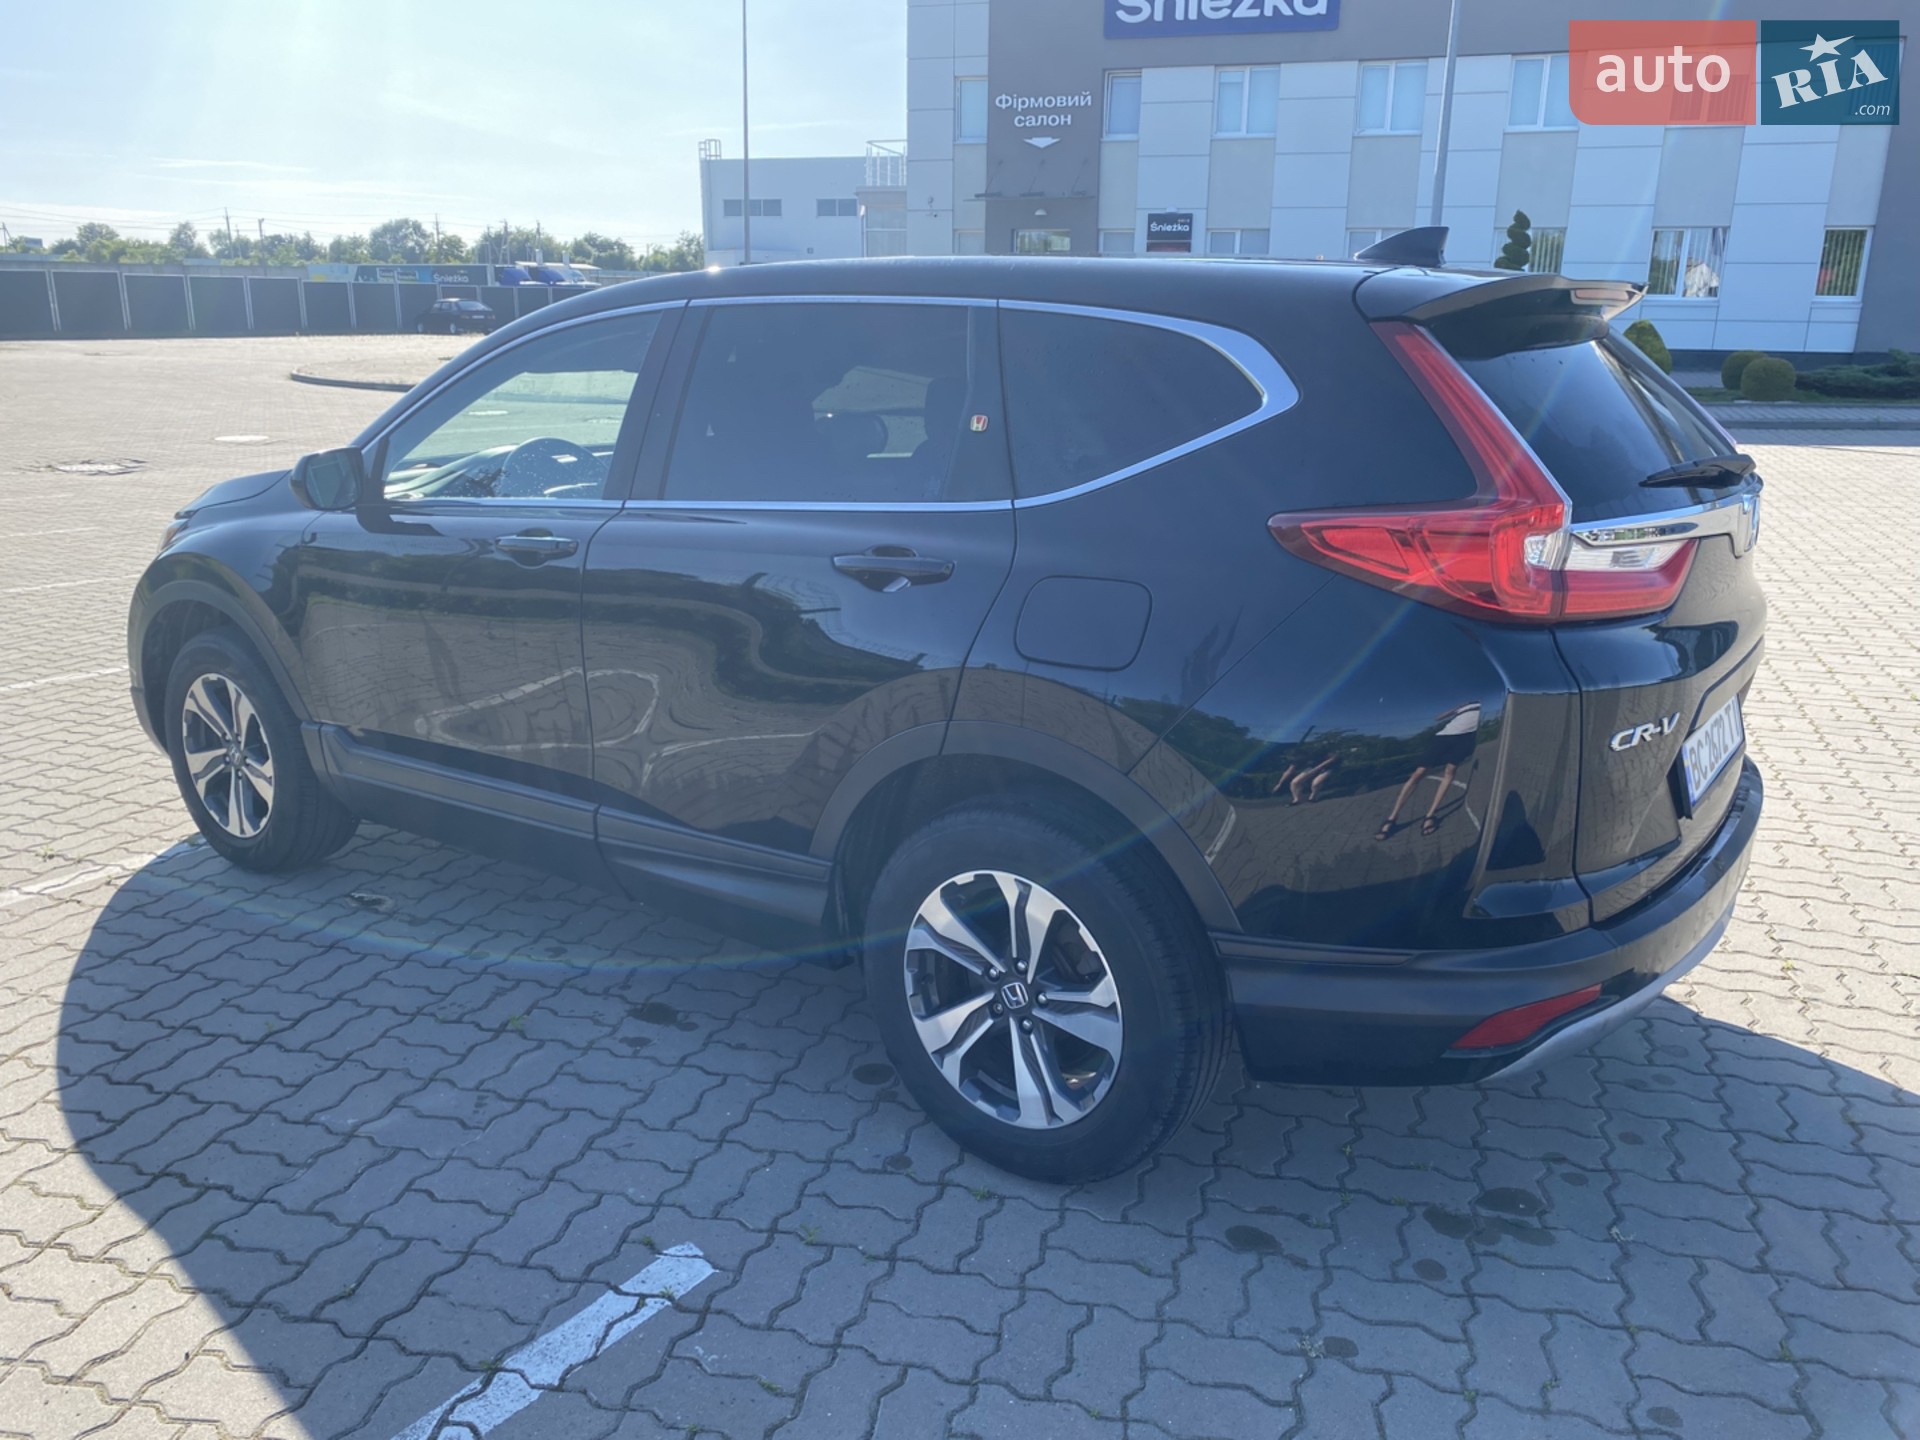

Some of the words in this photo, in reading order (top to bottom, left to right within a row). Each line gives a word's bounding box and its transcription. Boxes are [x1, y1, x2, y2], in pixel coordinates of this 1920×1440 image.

[995, 91, 1092, 112] Фірмовий
[1014, 114, 1072, 128] салон
[1609, 712, 1681, 752] CR-V
[1689, 739, 1708, 791] BC
